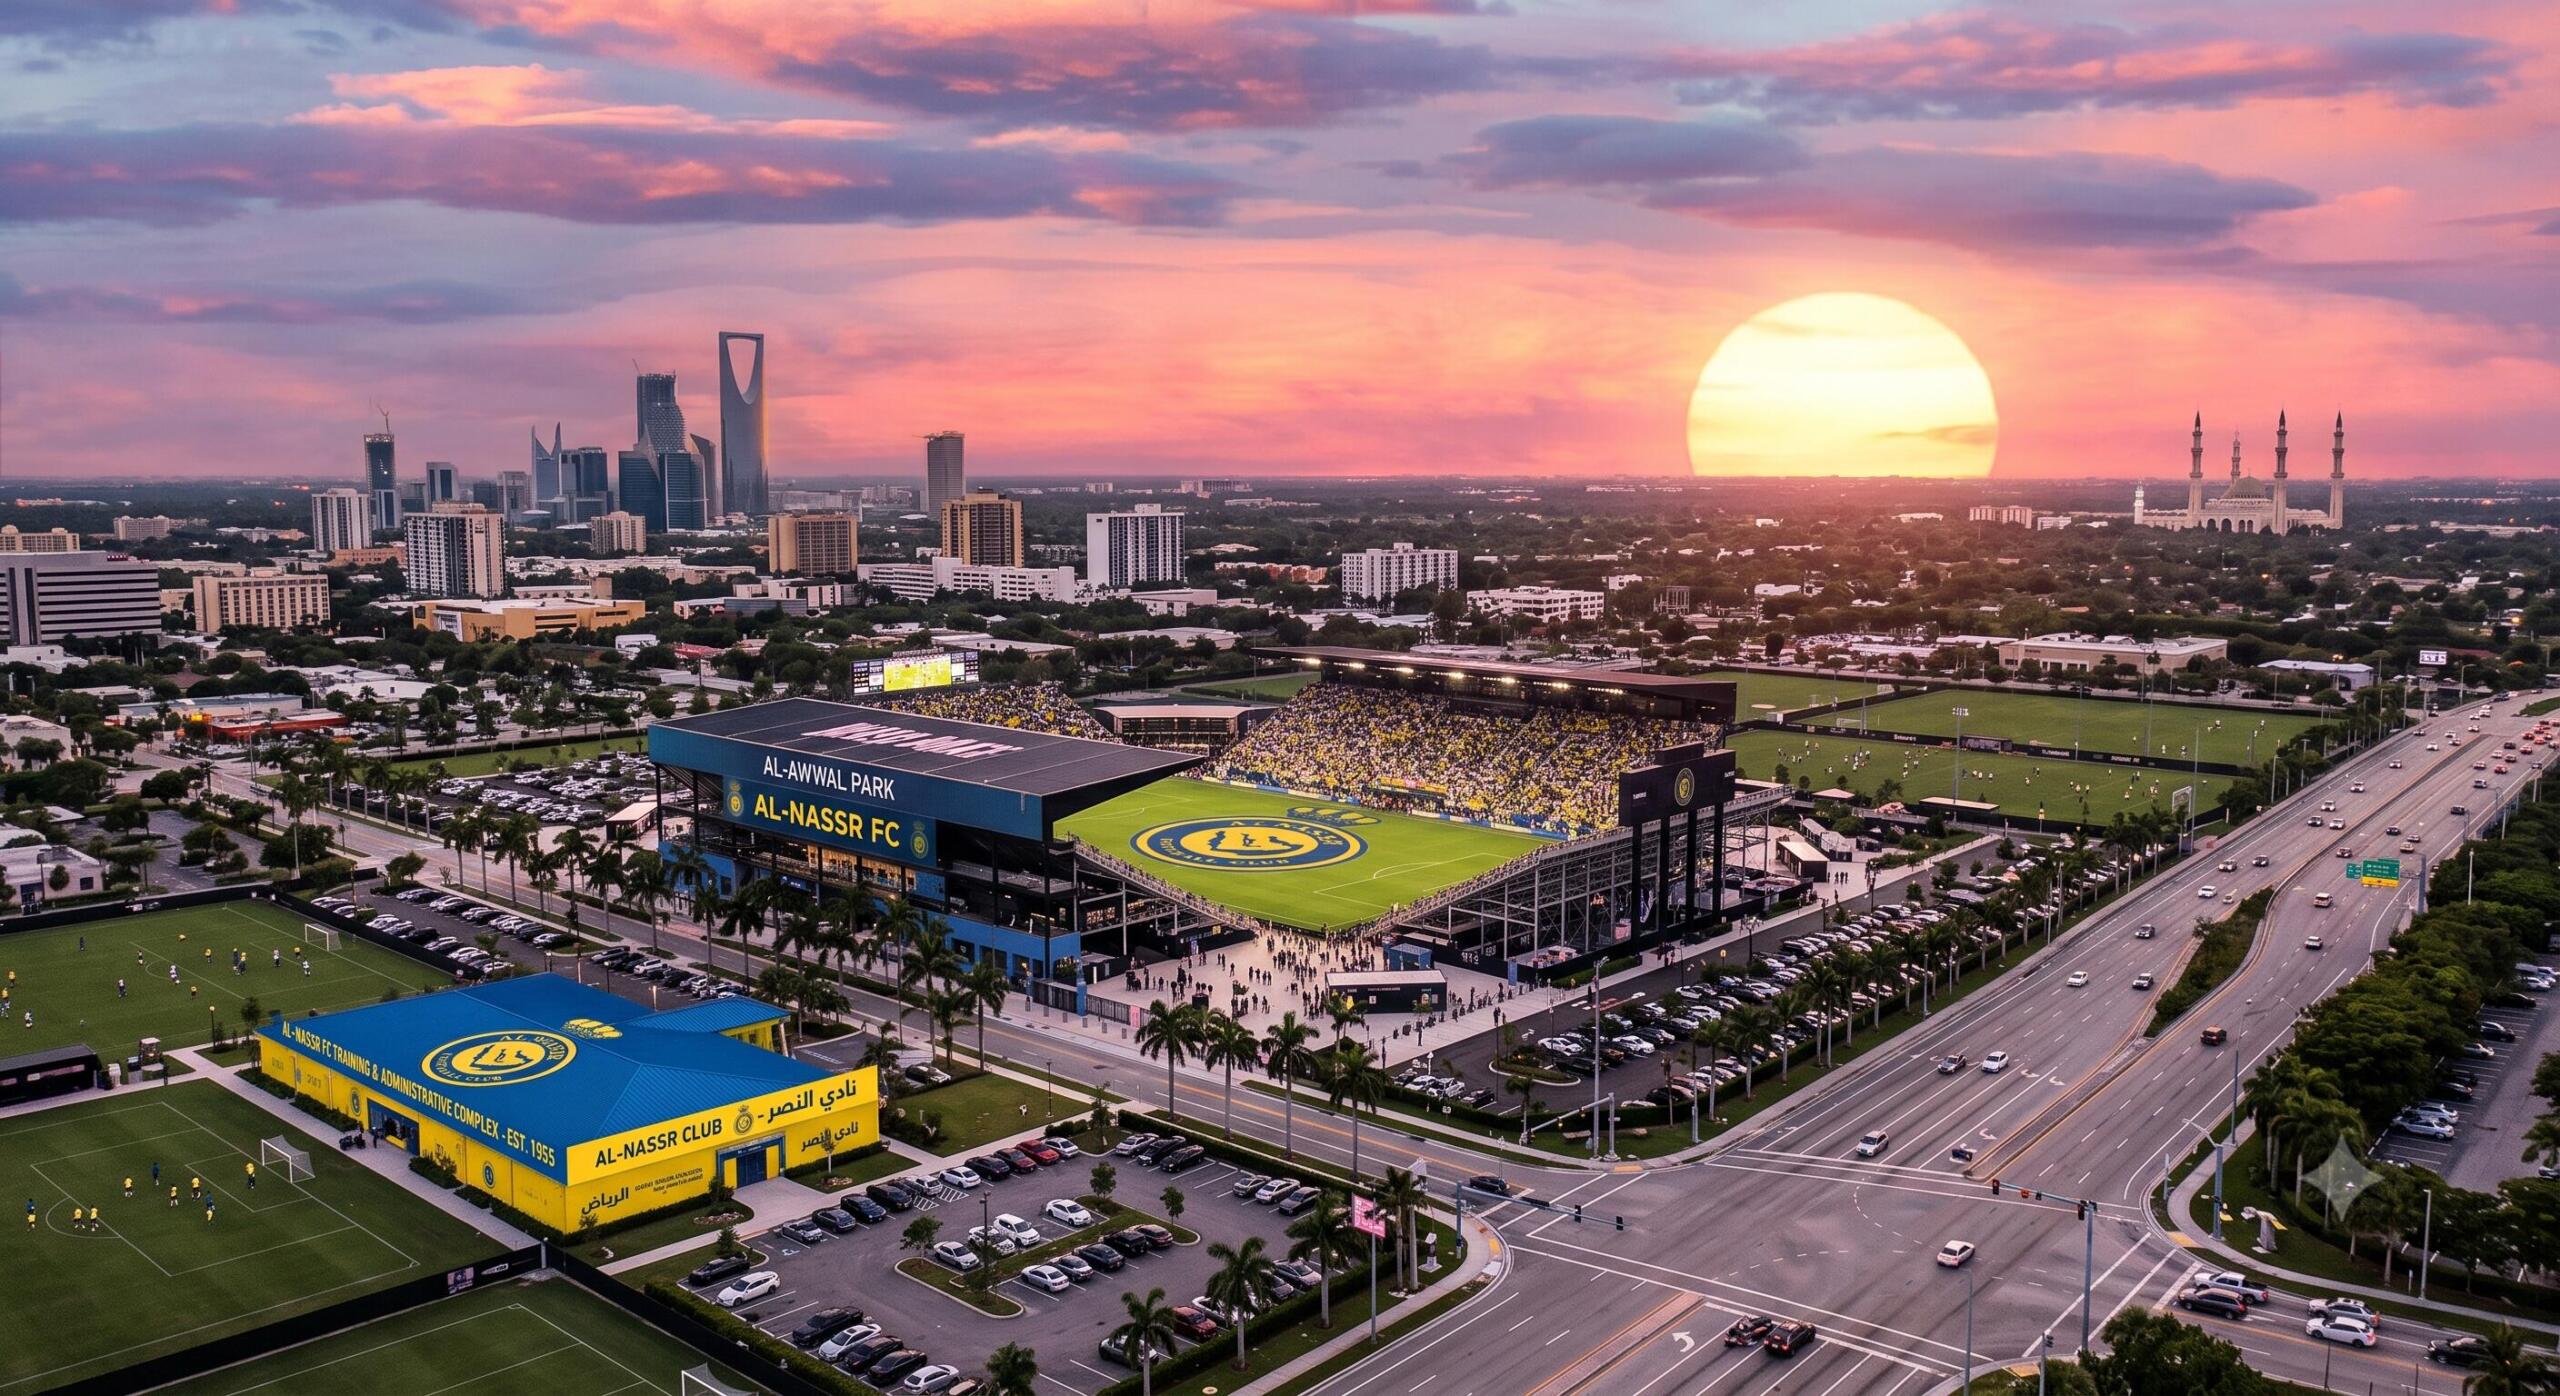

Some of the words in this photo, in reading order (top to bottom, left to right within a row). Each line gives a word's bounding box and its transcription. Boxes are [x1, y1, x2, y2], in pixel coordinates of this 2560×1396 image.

[763, 755, 847, 792] AL-AWWAL
[851, 771, 895, 800] PARK
[754, 793, 863, 840] AL-NASSR
[871, 817, 900, 848] FC
[282, 1020, 321, 1053] AL-NASSR
[322, 1039, 332, 1058] FC
[333, 1044, 371, 1077] TRAINING
[371, 1063, 379, 1081] &
[381, 1067, 453, 1117] ADMINISTRATIVE
[454, 1102, 499, 1140] COMPLEX
[530, 1139, 556, 1168] 1955
[768, 1090, 813, 1124] النصر
[820, 1079, 857, 1112] نادي
[595, 1130, 677, 1168] AL-NASSR
[682, 1118, 722, 1143] CLUB
[581, 1186, 629, 1215] الرياض
